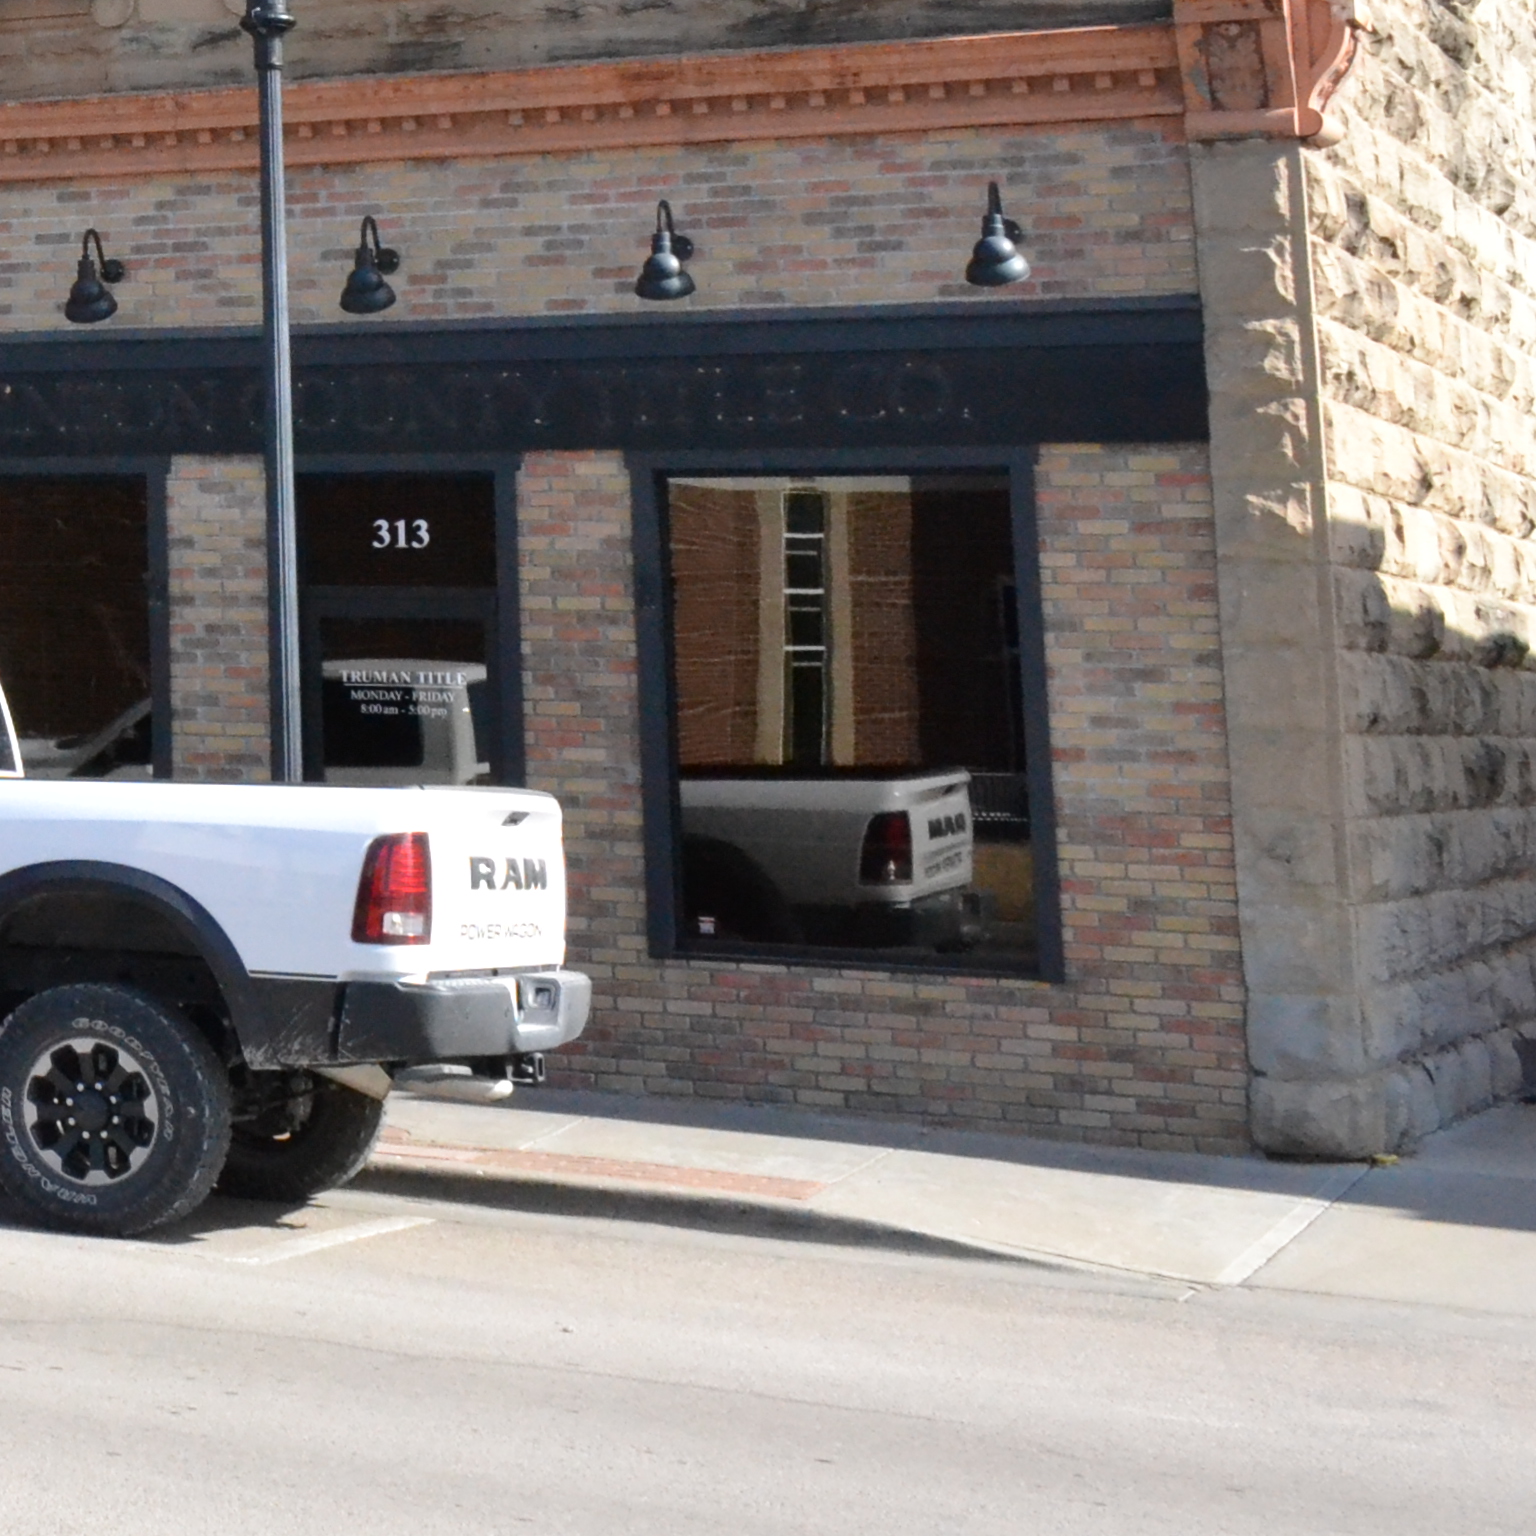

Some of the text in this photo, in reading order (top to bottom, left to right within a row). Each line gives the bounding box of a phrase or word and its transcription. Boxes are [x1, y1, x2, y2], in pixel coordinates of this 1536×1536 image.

[371, 518, 430, 549] 313
[339, 669, 468, 686] TRUMAN TITLE
[350, 689, 403, 702] MONDAY
[412, 690, 455, 703] FRIDAY
[469, 855, 548, 891] RAM
[504, 923, 542, 938] WAGON
